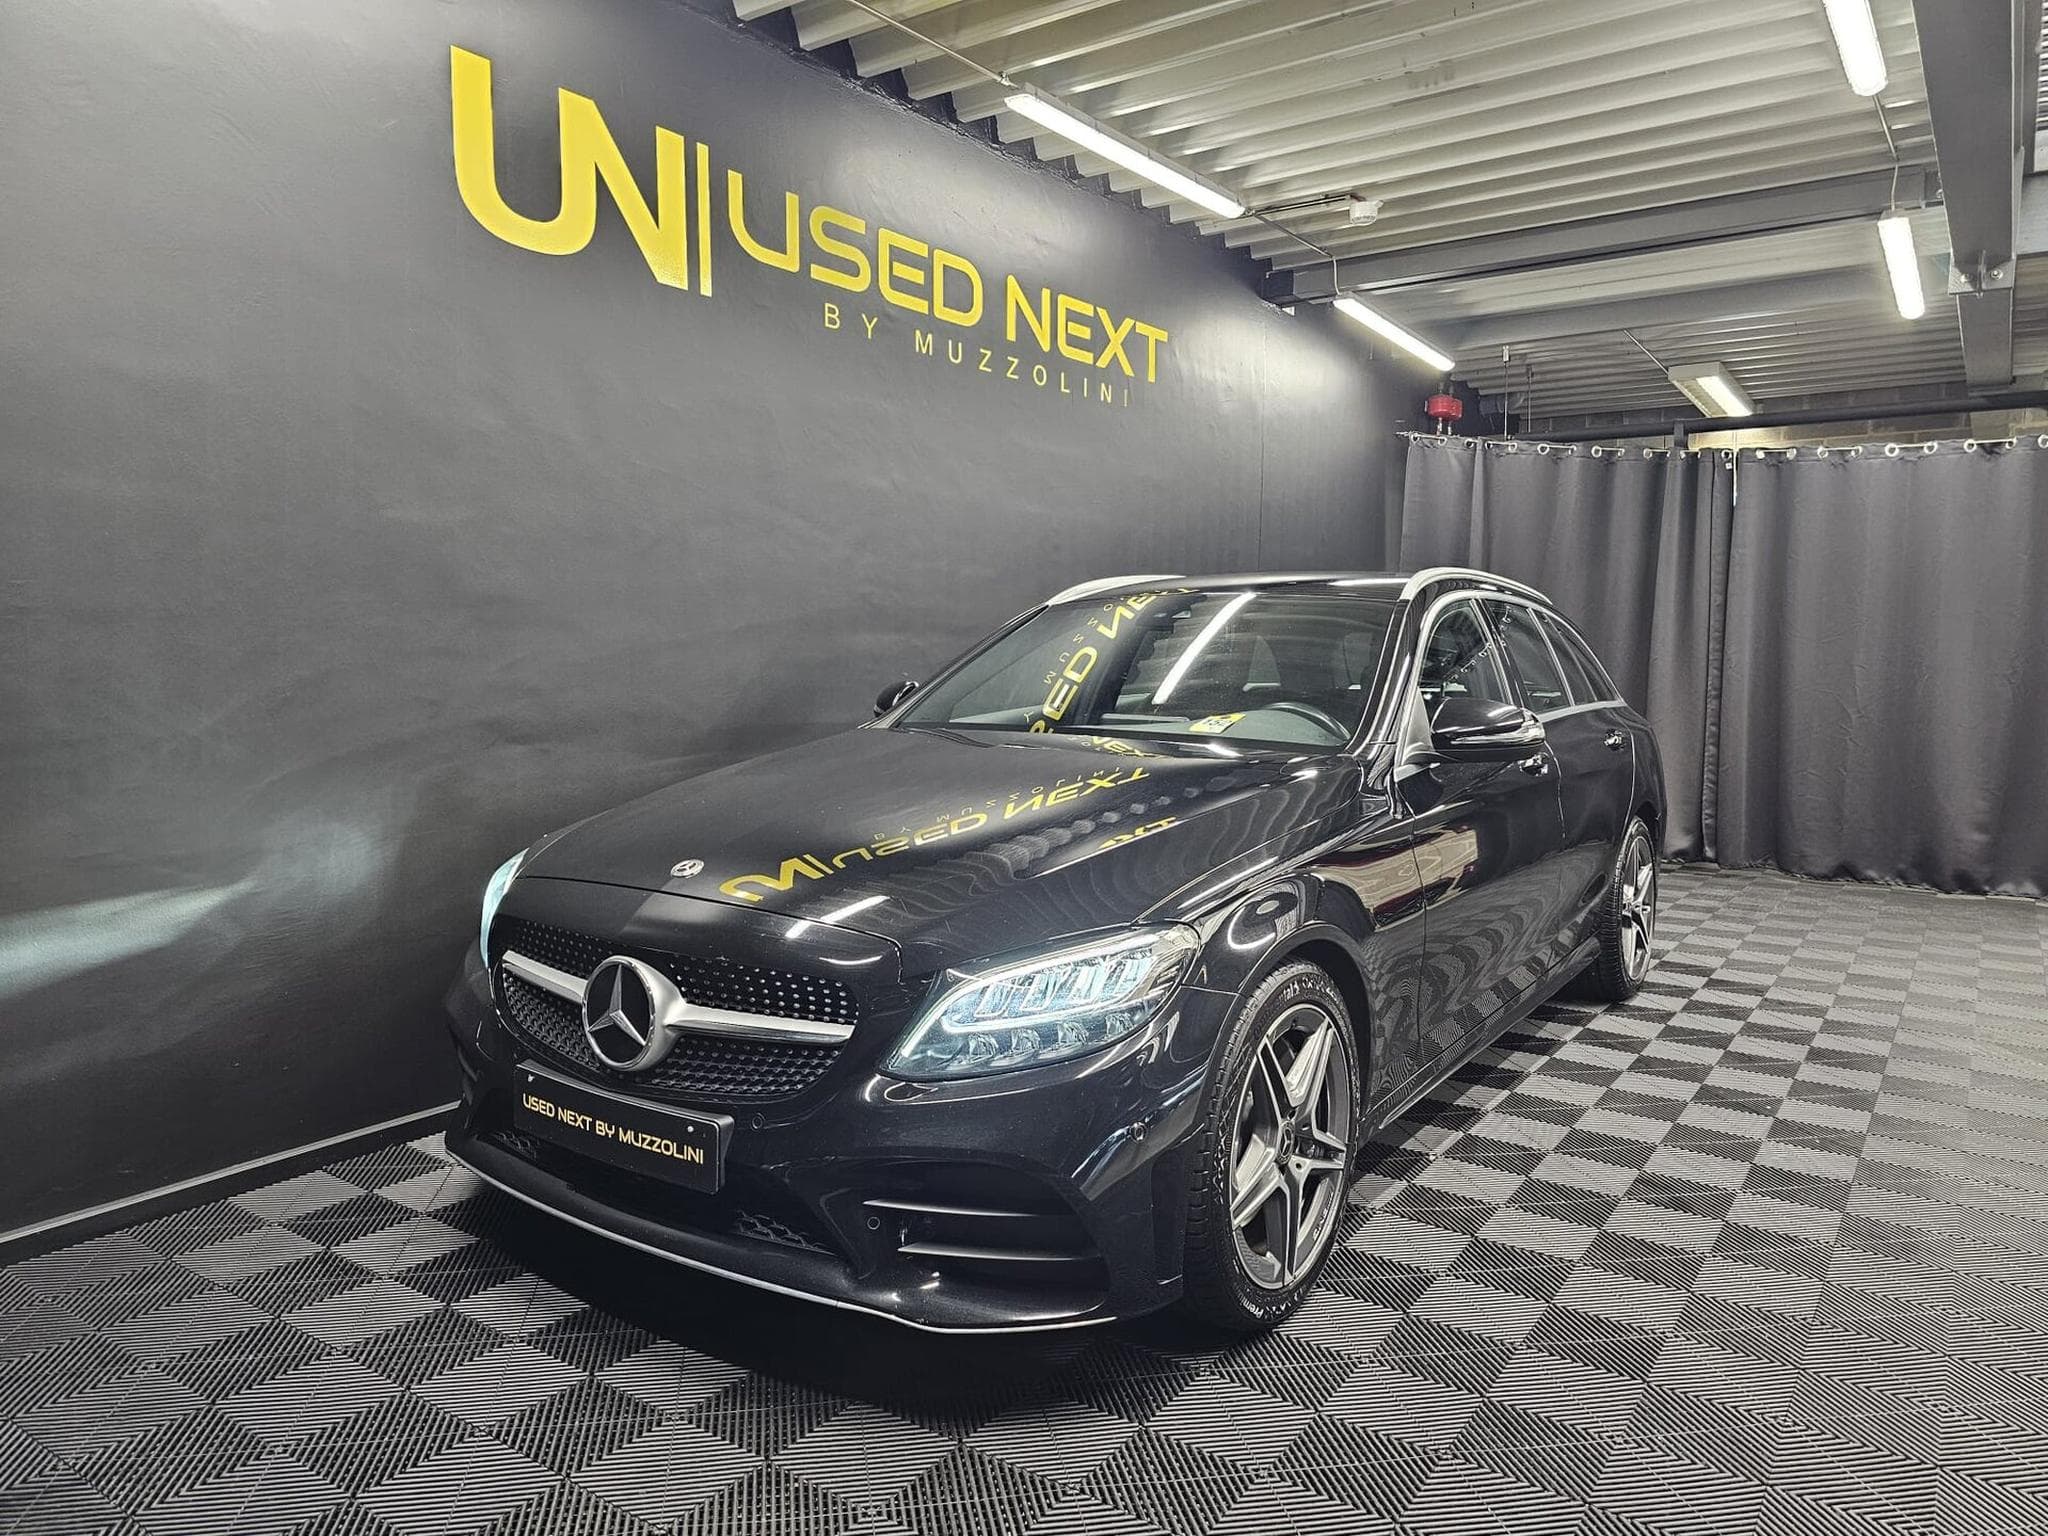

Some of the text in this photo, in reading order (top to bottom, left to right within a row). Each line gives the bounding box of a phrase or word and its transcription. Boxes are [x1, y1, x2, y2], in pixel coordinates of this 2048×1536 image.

[727, 169, 1169, 384] USED NEXT
[823, 302, 1130, 407] BY MUZZOLINI
[522, 1092, 705, 1165] USED NEXT BY MUZZOLINI
